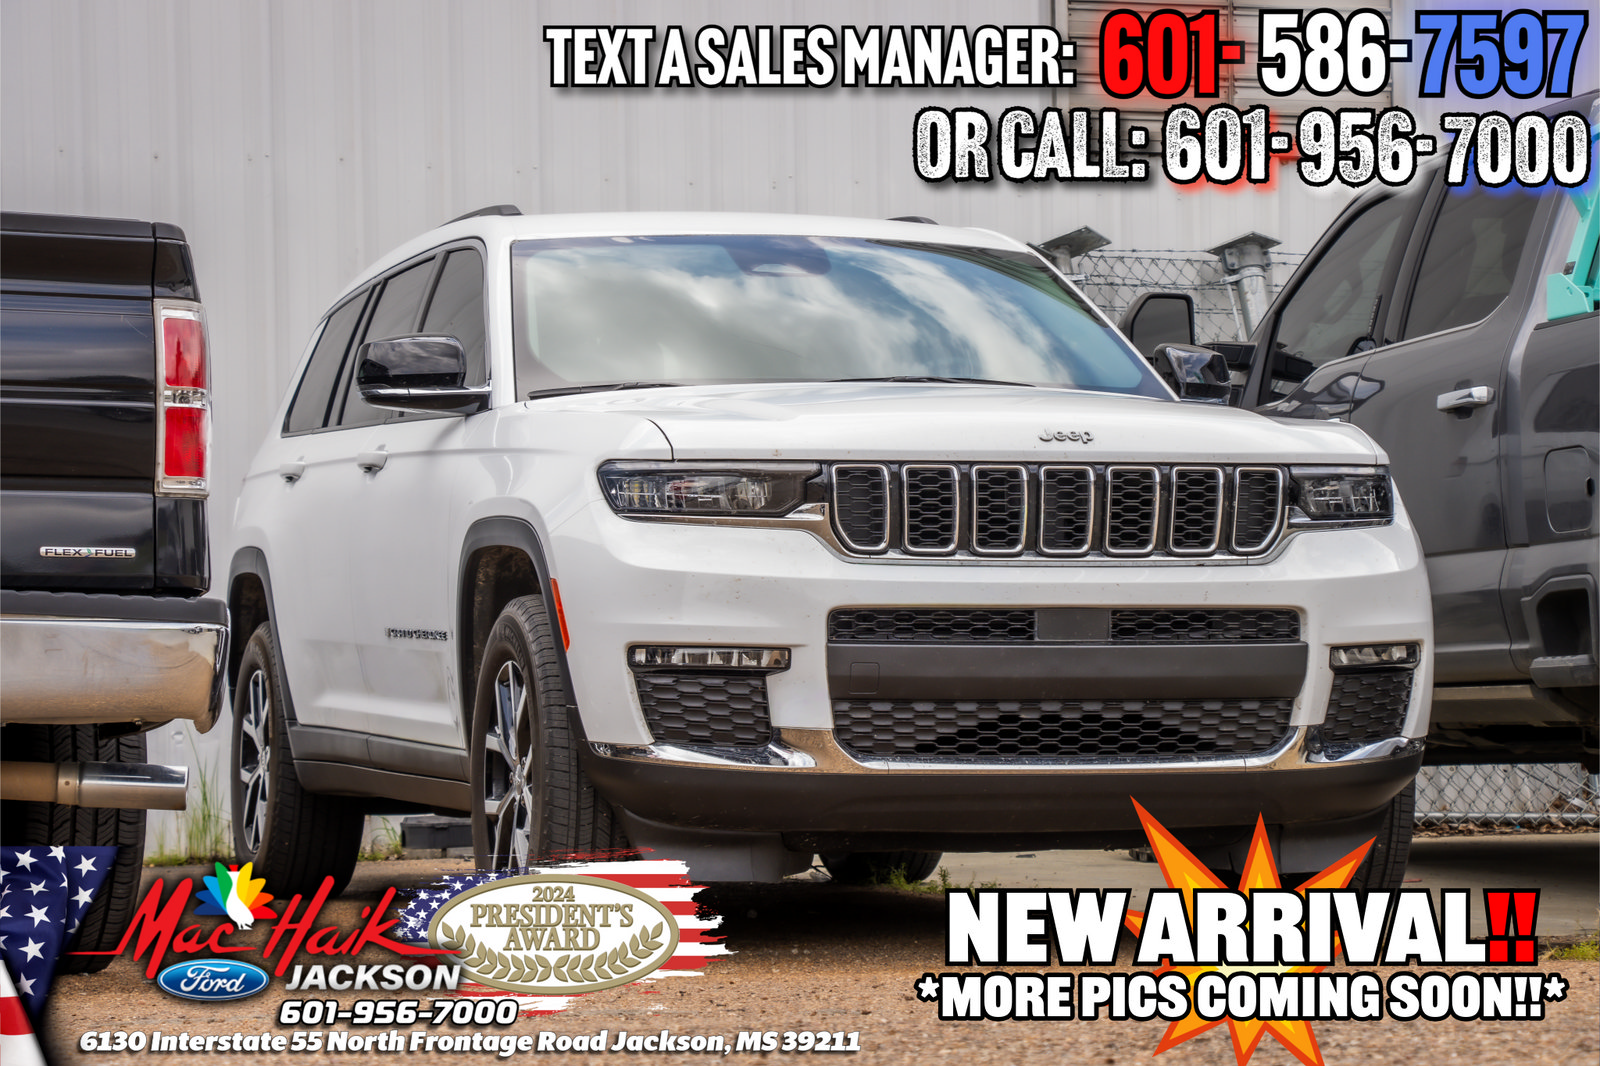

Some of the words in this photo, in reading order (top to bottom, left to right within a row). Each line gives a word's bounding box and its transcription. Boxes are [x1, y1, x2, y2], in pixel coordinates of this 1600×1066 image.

[1038, 427, 1094, 444] Jeep
[45, 548, 82, 556] FLEX
[94, 549, 132, 557] FUEL
